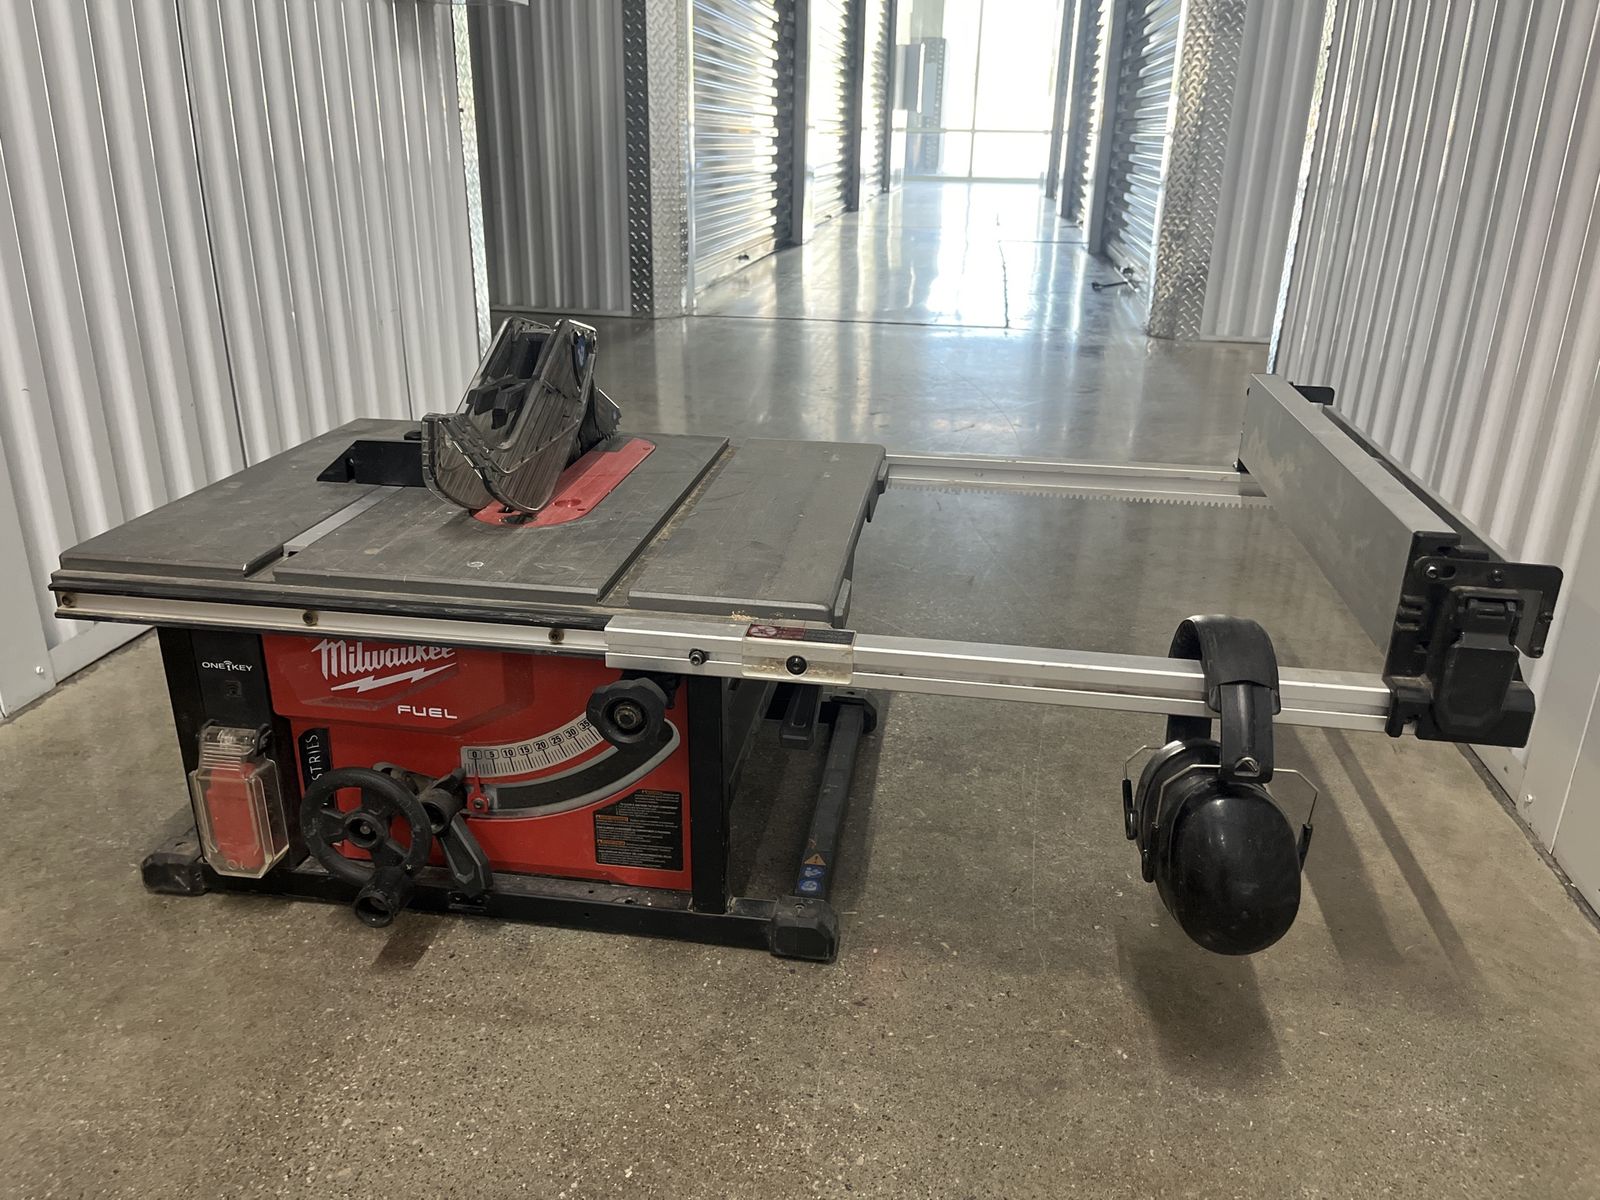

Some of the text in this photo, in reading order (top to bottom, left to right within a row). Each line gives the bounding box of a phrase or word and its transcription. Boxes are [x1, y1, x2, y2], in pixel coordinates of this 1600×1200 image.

[311, 638, 456, 680] Milwaukee
[397, 705, 458, 719] FUEL
[305, 734, 323, 781] STRIES
[503, 749, 514, 757] 10
[519, 746, 530, 754] 15
[535, 741, 547, 750] 20
[550, 736, 562, 745] 25
[565, 728, 577, 738] 30
[579, 719, 590, 730] 35
